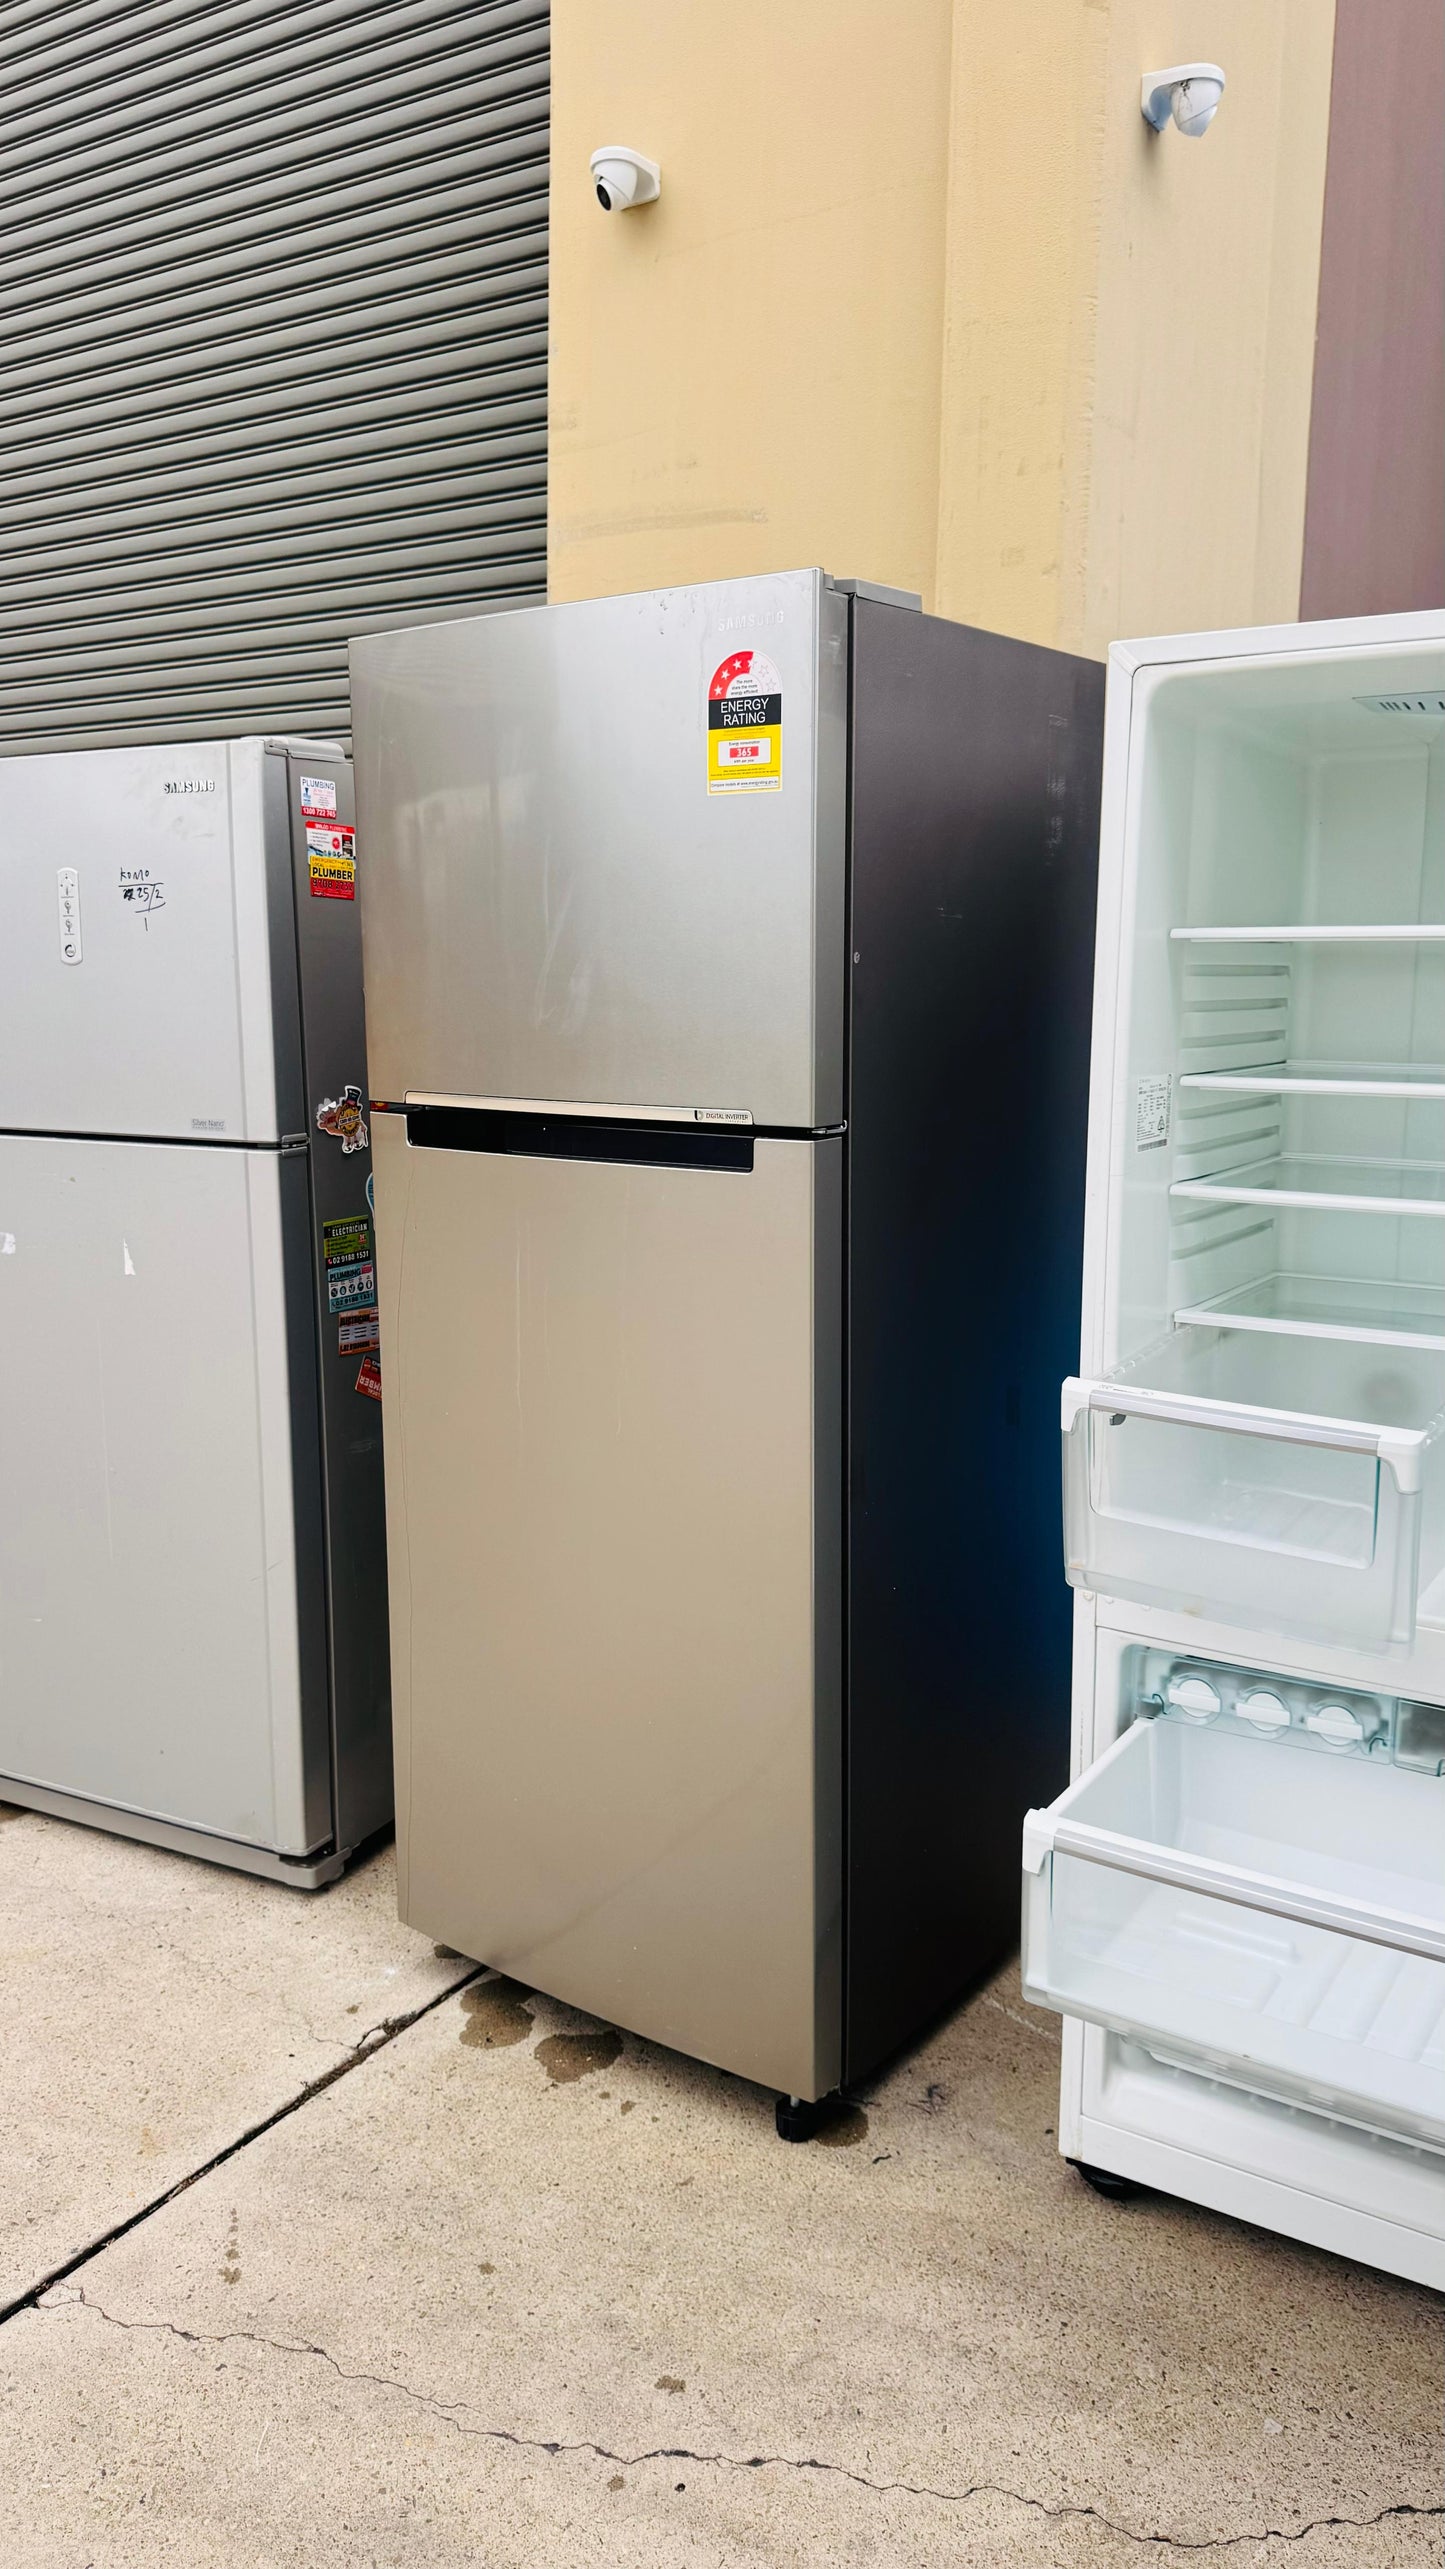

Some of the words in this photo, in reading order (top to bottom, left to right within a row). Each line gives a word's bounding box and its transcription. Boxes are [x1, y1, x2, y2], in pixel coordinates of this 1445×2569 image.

[718, 610, 785, 631] SAMSUNG
[720, 698, 769, 713] ENERGY
[723, 712, 766, 726] RATING
[736, 748, 752, 757] 365
[164, 780, 216, 794] SAMSUNG
[302, 778, 335, 790] PLUMBING
[303, 807, 316, 816] 1300
[312, 867, 353, 880] PLUMBER
[706, 1112, 725, 1120] DIGITAL
[725, 1113, 749, 1121] INVERTER
[332, 1223, 368, 1237] ELECTRICIAN
[332, 1256, 341, 1264] 02
[356, 1250, 369, 1259] 1531
[330, 1268, 361, 1282] PLUMBING
